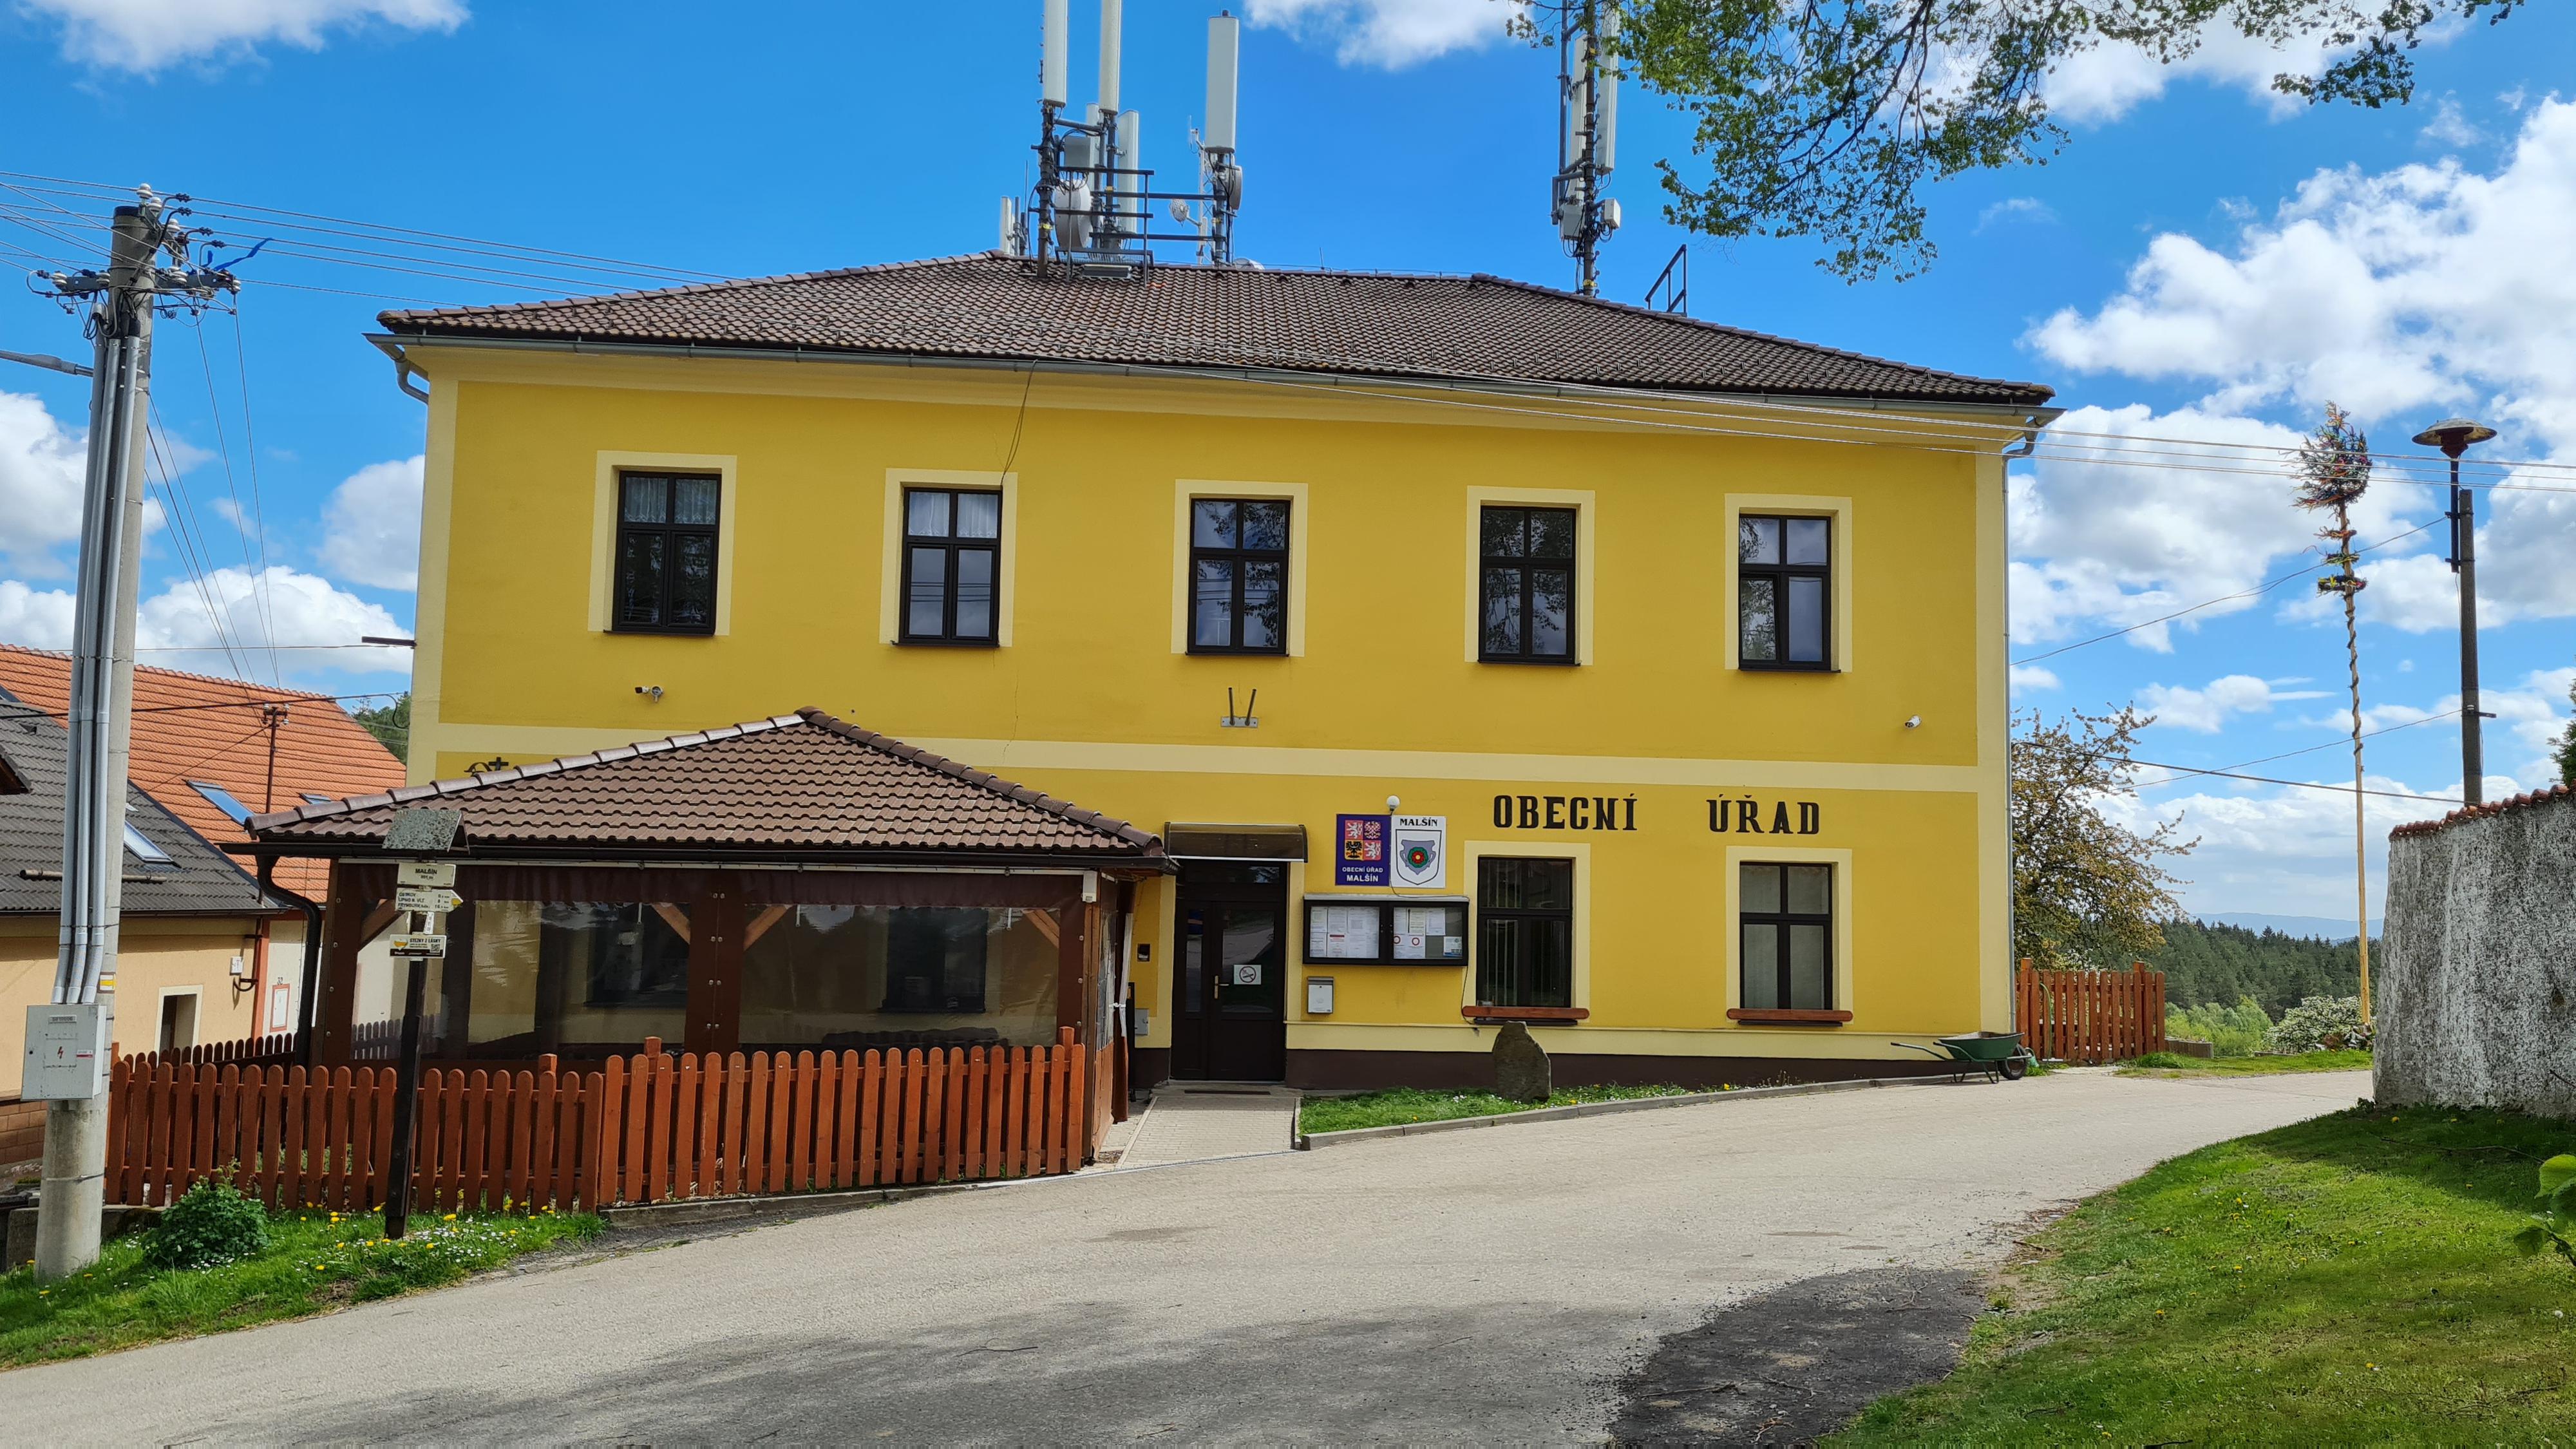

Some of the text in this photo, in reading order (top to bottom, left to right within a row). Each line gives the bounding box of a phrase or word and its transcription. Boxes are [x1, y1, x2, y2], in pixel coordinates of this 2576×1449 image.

[1400, 817, 1437, 826] MALŠÍN
[1493, 793, 1821, 835] OBECNÍ ÚŘAD
